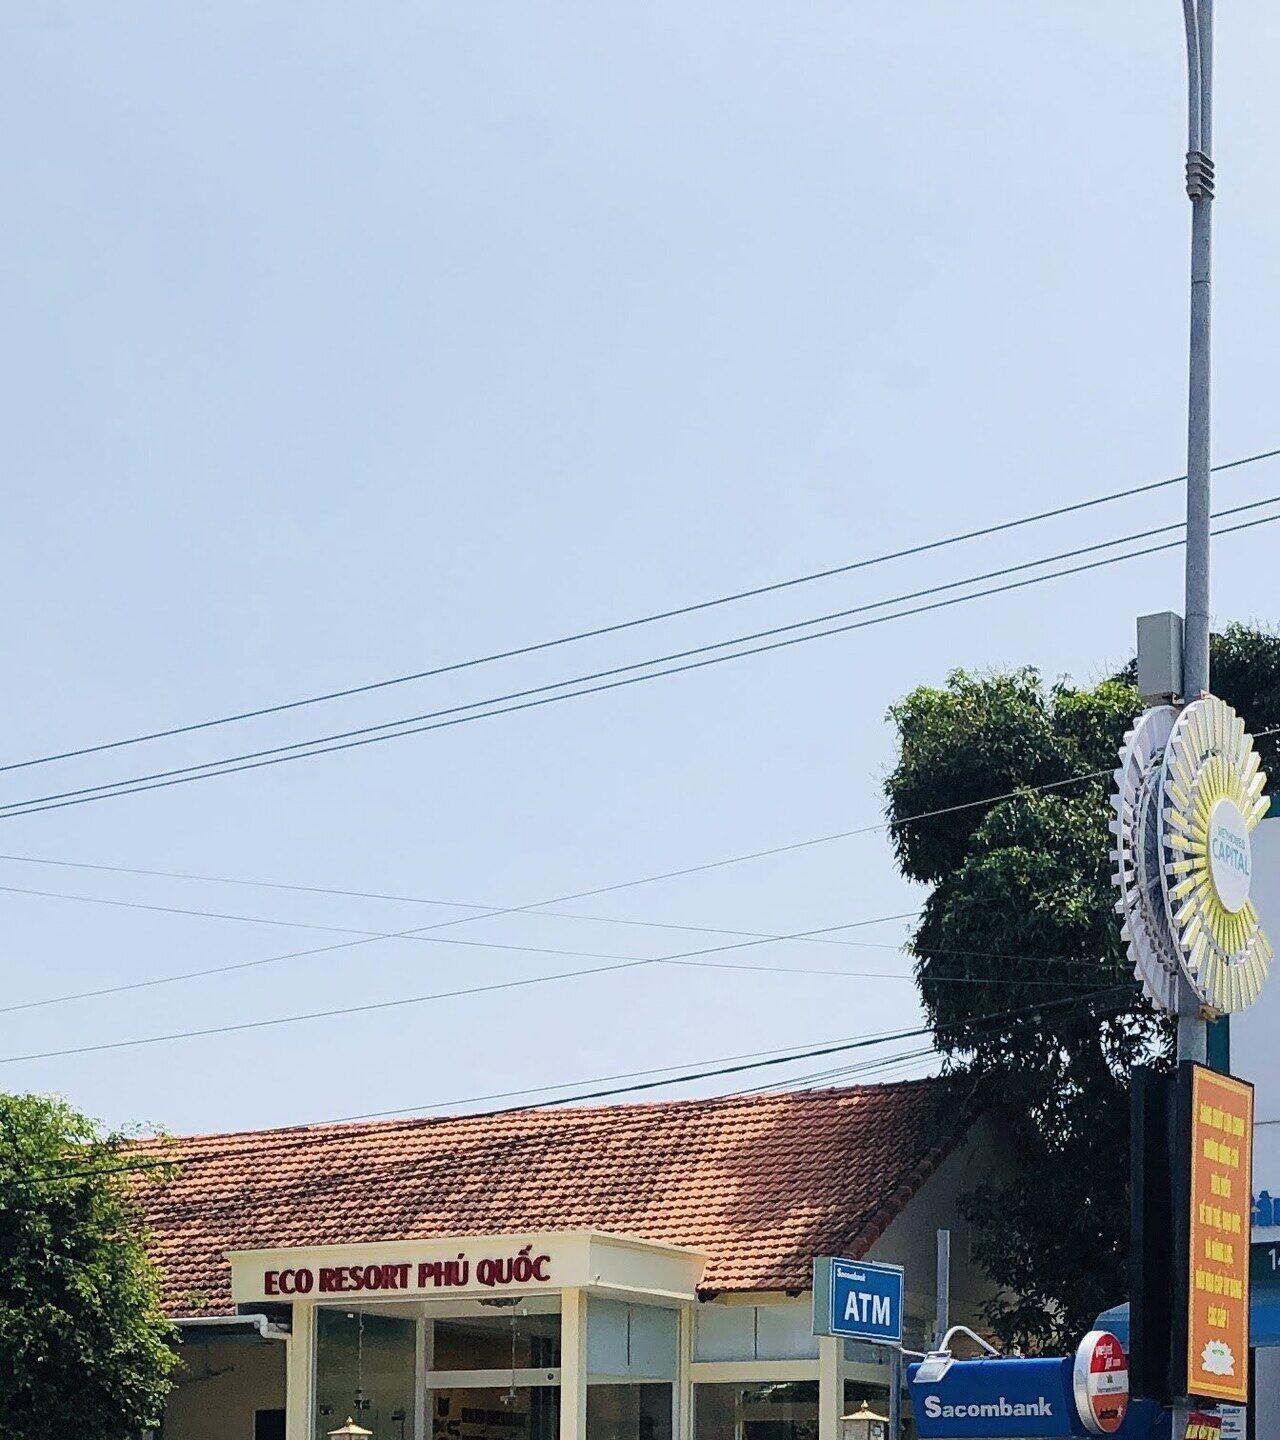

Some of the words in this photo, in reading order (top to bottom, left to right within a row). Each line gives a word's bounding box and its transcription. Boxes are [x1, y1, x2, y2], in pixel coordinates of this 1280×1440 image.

[263, 1266, 314, 1296] ECO
[318, 1263, 413, 1293] RESORT
[417, 1253, 469, 1289] PHÚ
[476, 1244, 551, 1287] QUỐC
[844, 1290, 891, 1327] ATM
[924, 1395, 1053, 1419] Sacombank
